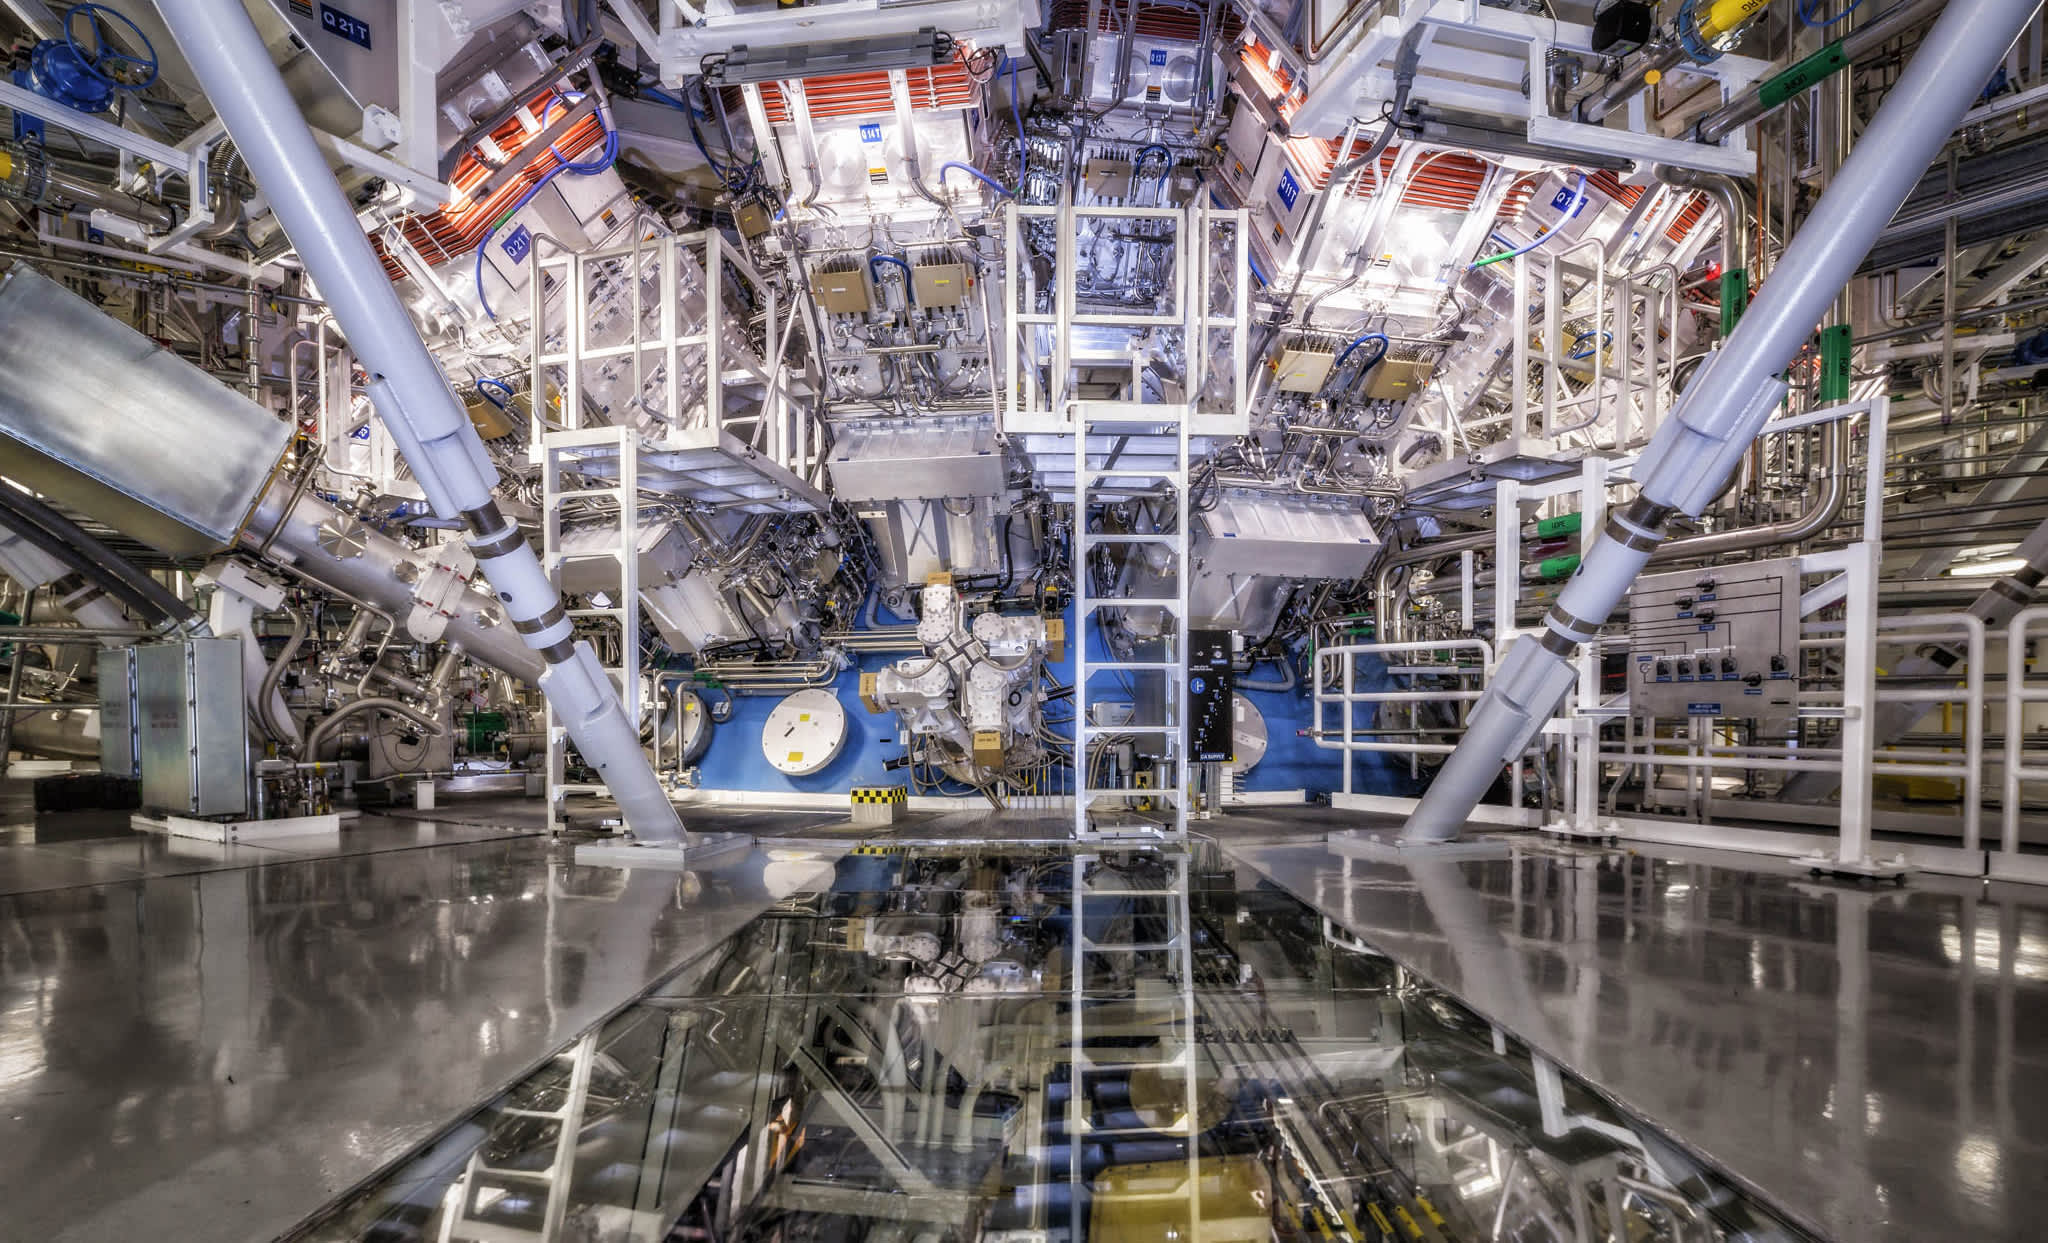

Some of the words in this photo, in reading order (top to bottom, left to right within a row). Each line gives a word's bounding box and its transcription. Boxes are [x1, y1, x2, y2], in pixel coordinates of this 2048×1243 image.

[323, 11, 336, 27] Q
[1281, 175, 1287, 190] Q
[1556, 192, 1566, 203] Q
[507, 246, 518, 257] Q
